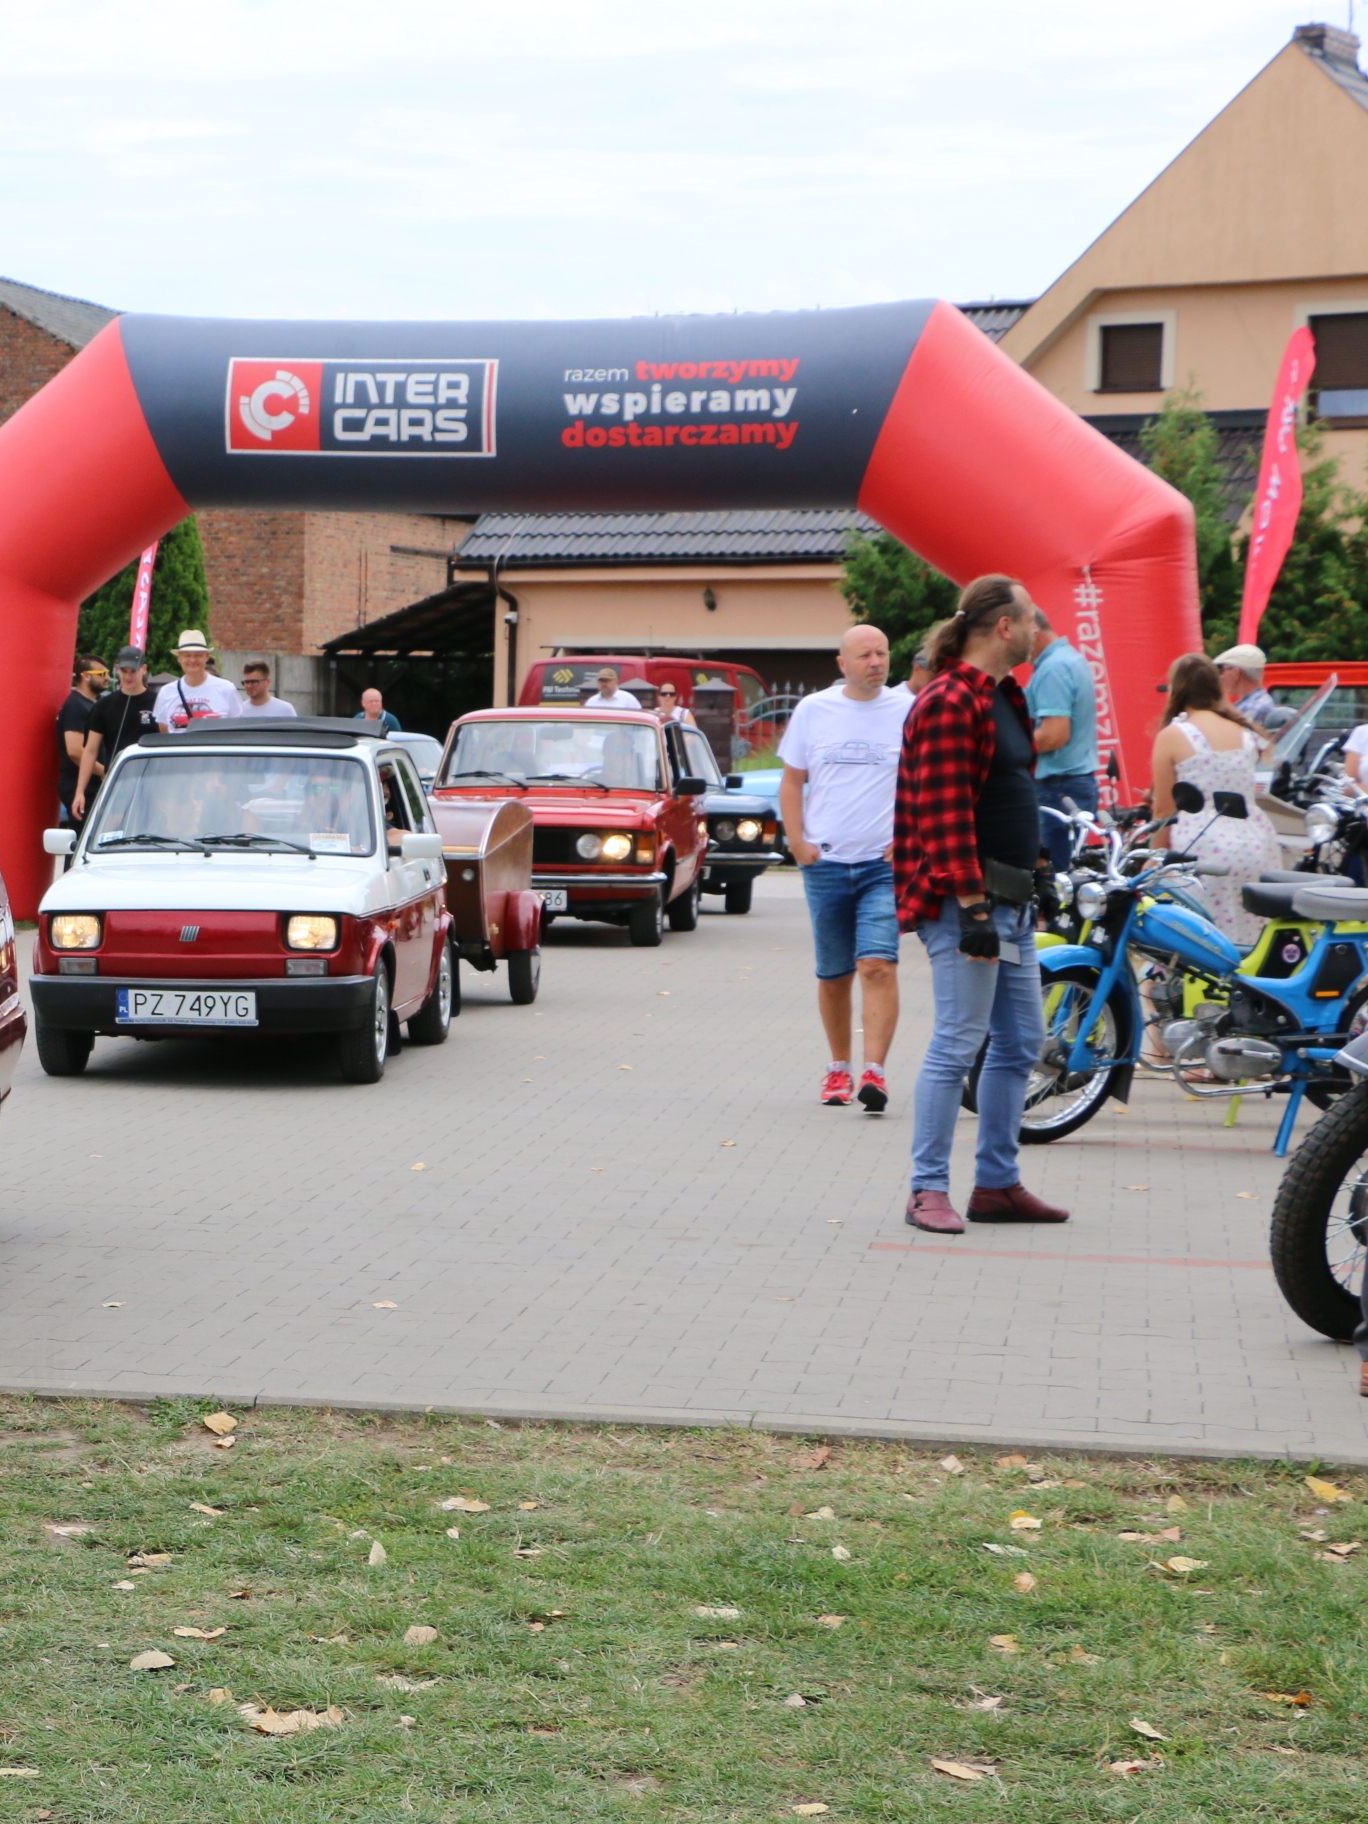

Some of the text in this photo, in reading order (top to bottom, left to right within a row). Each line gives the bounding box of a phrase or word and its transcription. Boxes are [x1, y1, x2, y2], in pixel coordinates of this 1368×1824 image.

[563, 357, 801, 384] razem tworzymy
[333, 372, 470, 405] INTER
[563, 383, 799, 422] wspieramy
[333, 408, 469, 442] CARS
[560, 420, 801, 450] dostarczamy
[134, 993, 164, 1016] PZ
[173, 994, 250, 1018] 749YG
